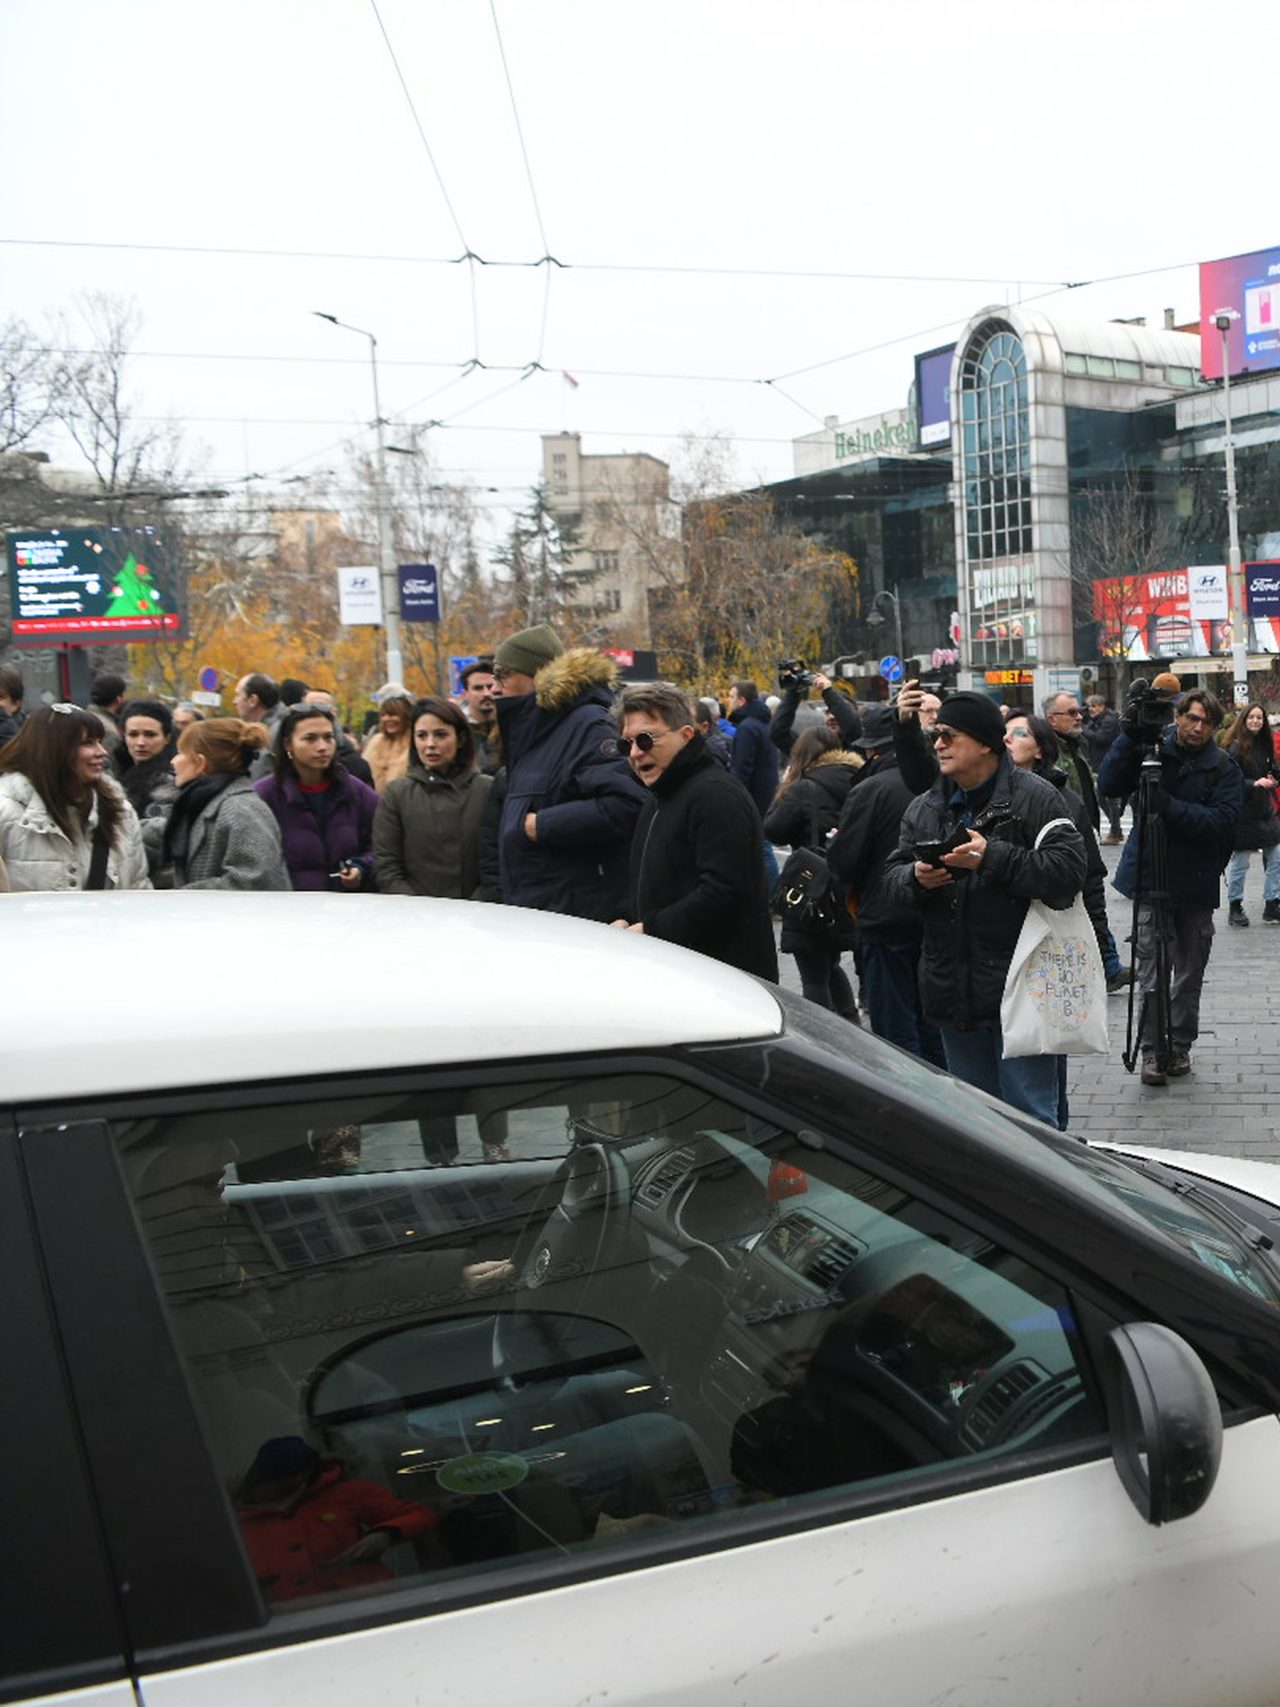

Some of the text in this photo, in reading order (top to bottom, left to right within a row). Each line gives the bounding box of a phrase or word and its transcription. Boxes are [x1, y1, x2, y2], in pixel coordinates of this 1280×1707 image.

[834, 419, 917, 459] Heineken
[402, 578, 435, 595] Ford
[1147, 575, 1188, 598] WINB
[1249, 577, 1280, 592] Ford
[1040, 950, 1087, 967] THERE IS
[1045, 982, 1088, 999] PLANET
[1063, 1000, 1073, 1017] B
